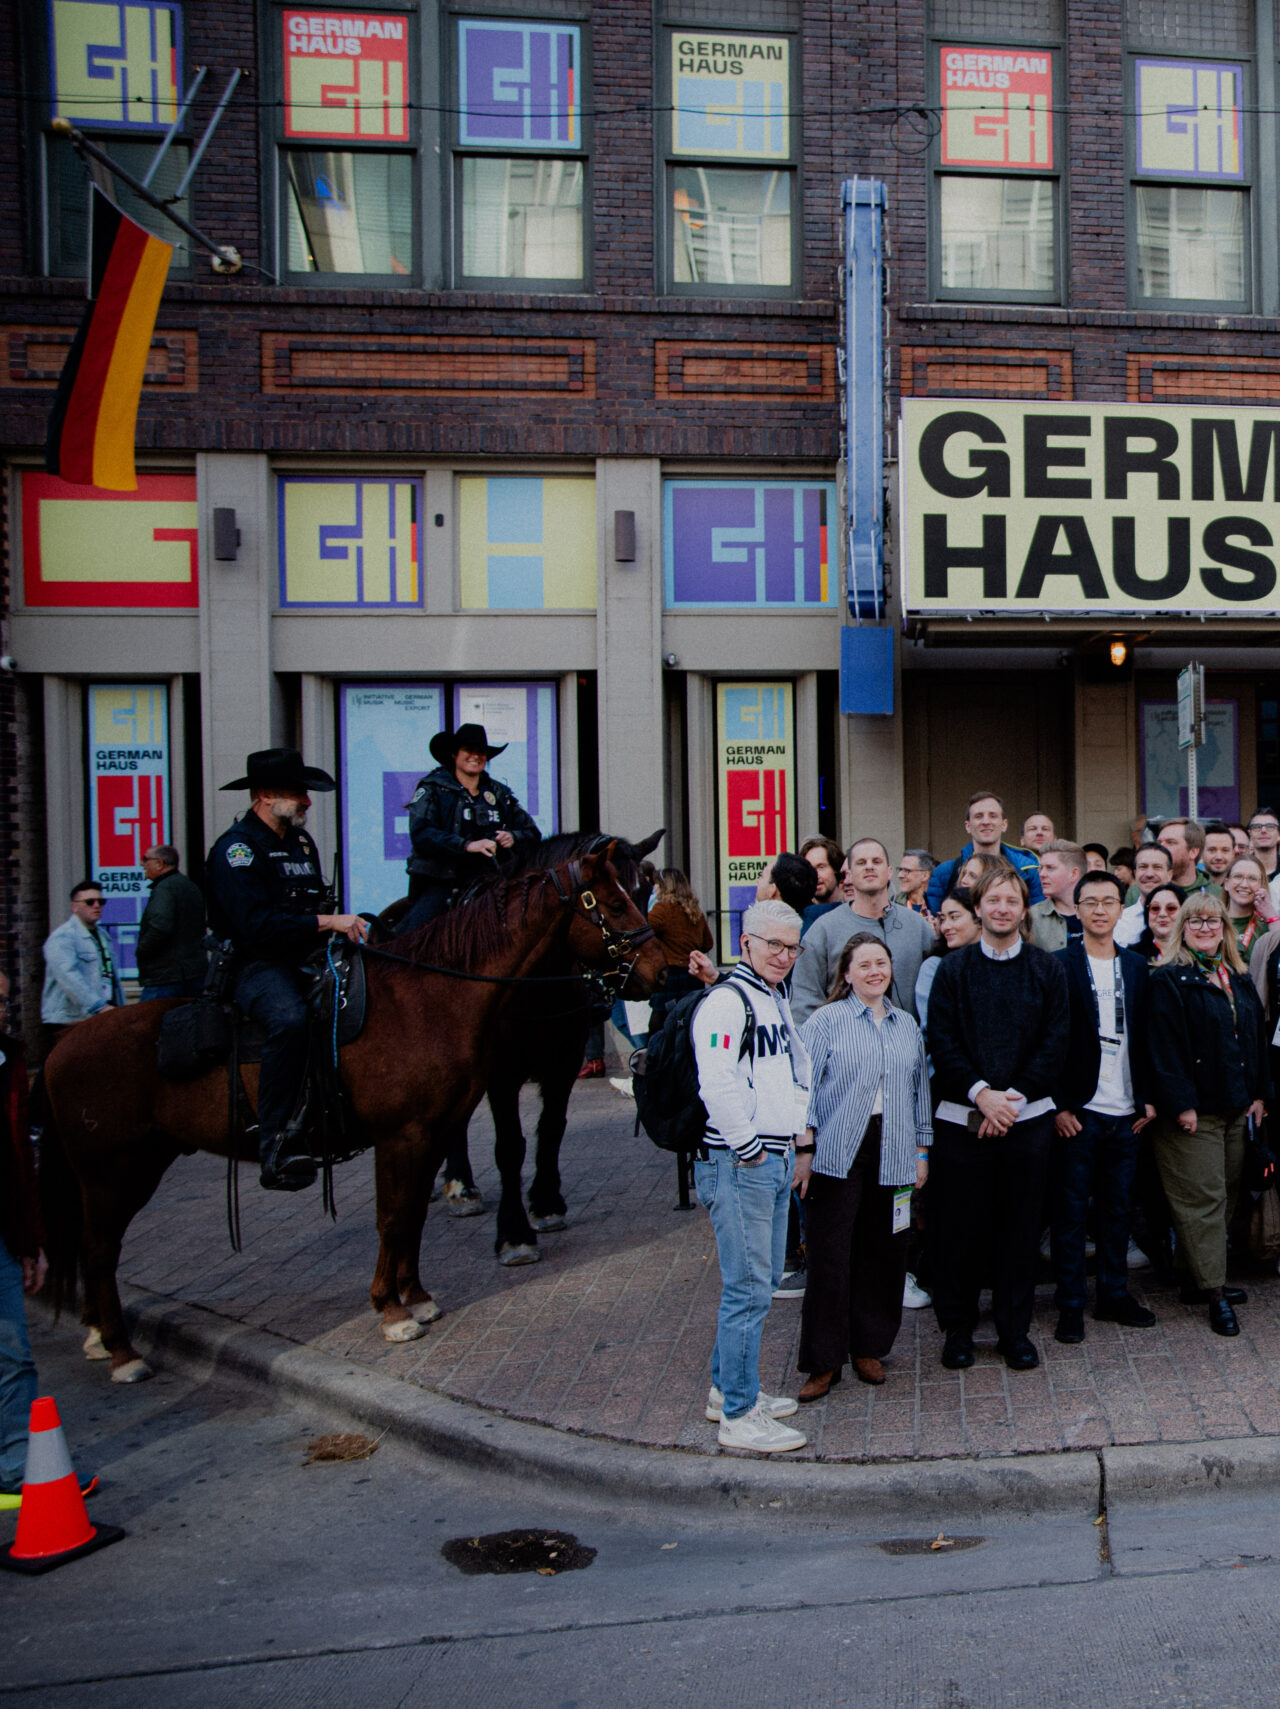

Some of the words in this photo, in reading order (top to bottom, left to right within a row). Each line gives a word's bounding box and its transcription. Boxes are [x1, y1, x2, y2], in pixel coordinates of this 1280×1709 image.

[289, 16, 404, 39] GERMAN
[289, 35, 362, 55] HAUS
[678, 40, 784, 61] GERMAN
[678, 57, 745, 75] HAUS
[946, 52, 1047, 74] GERMAN
[946, 70, 1010, 90] HAUS
[922, 513, 1278, 602] HAUS
[96, 750, 163, 760] GERMAN
[726, 746, 786, 755] GERMAN
[96, 760, 139, 771] HAUS
[726, 756, 764, 765] HAUS
[728, 862, 768, 872] GERM
[98, 872, 146, 883] GERM
[100, 882, 142, 893] HAUS
